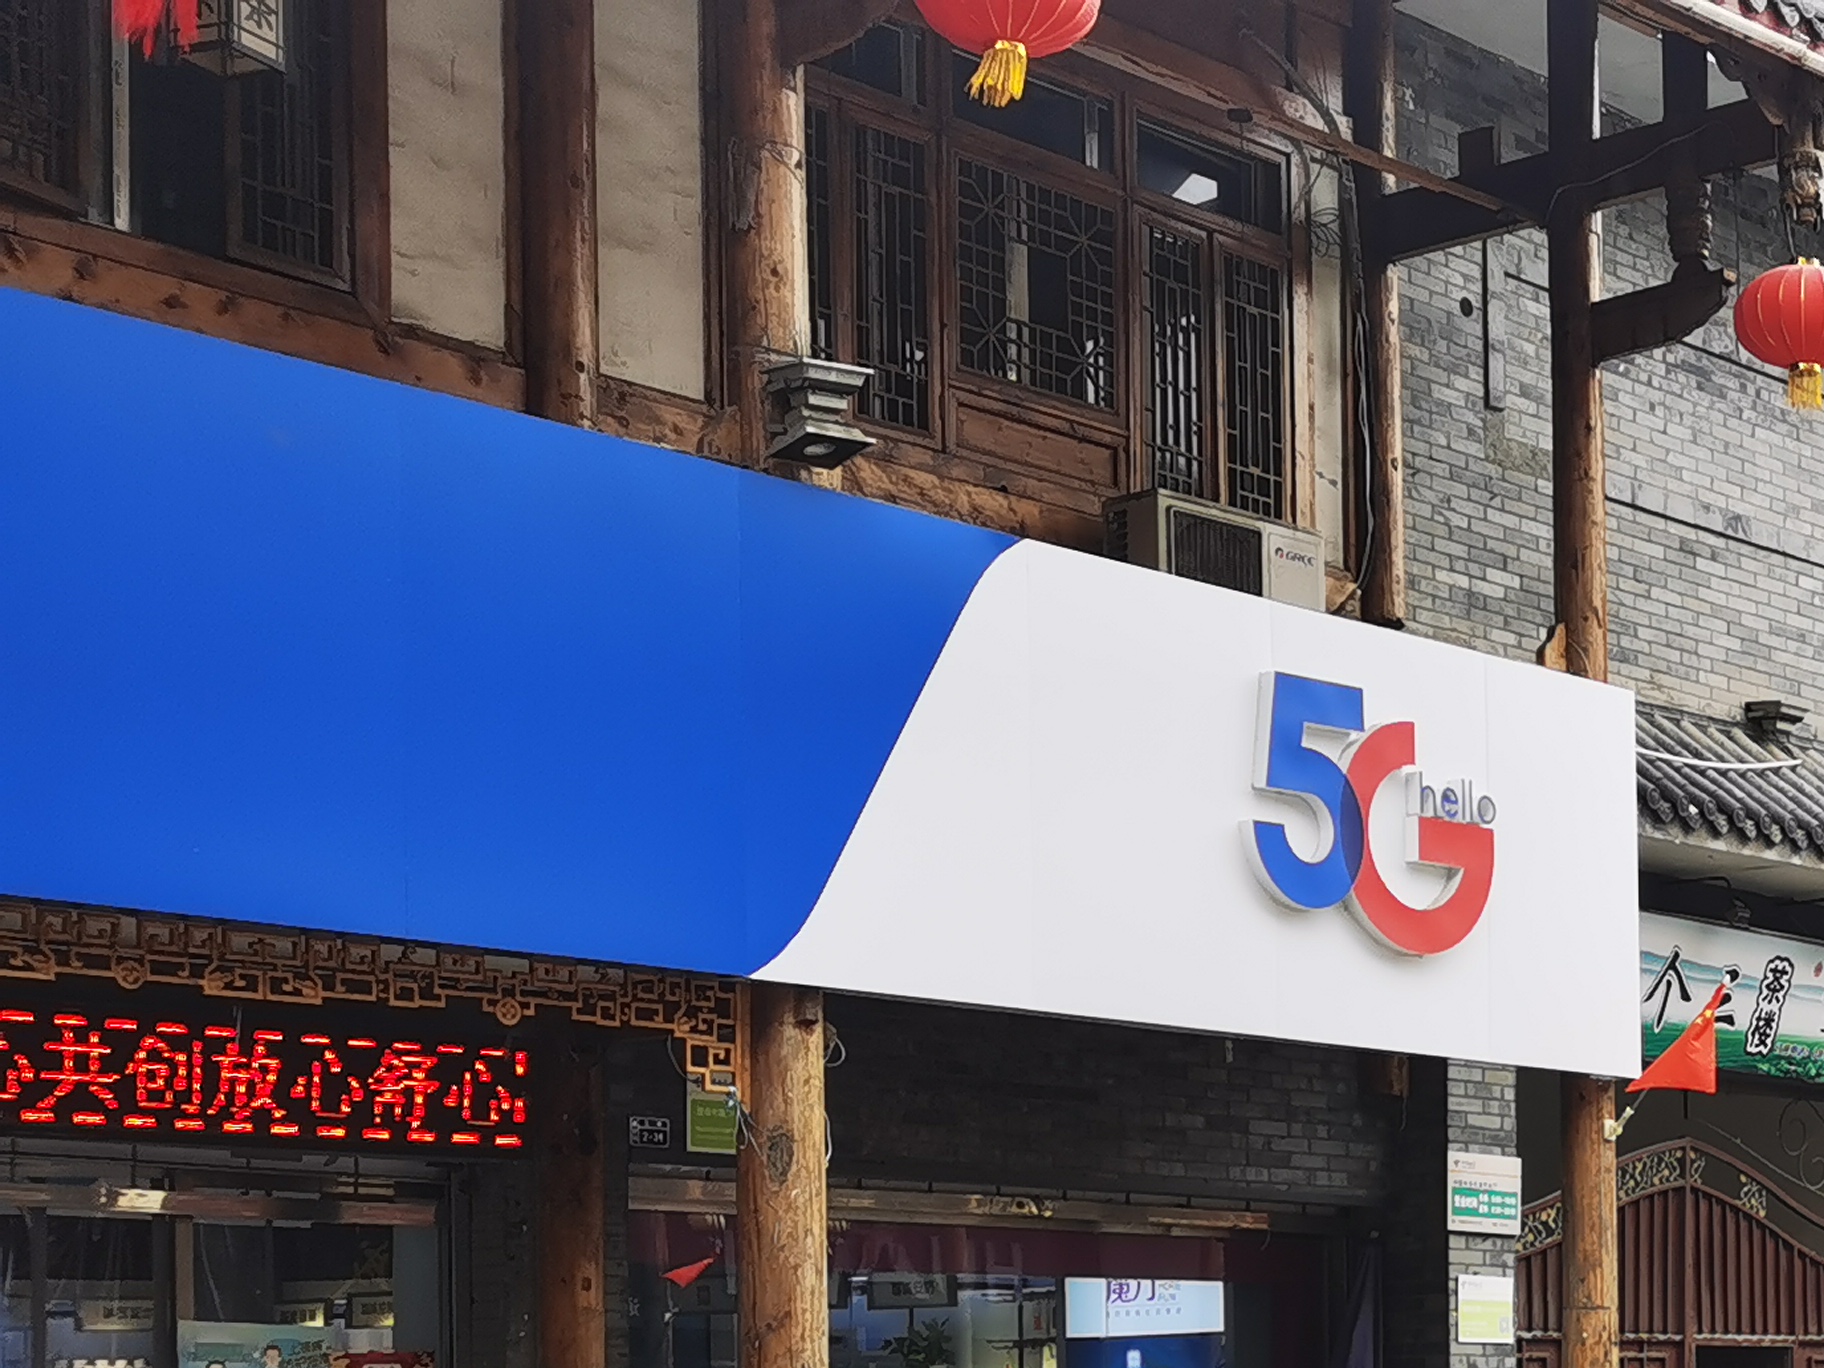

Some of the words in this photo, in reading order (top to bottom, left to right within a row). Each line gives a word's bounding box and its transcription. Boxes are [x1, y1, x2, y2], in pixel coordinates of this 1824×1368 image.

[1241, 671, 1494, 956] 5G
[1418, 770, 1497, 825] hello
[1746, 957, 1794, 1057] 茶楼
